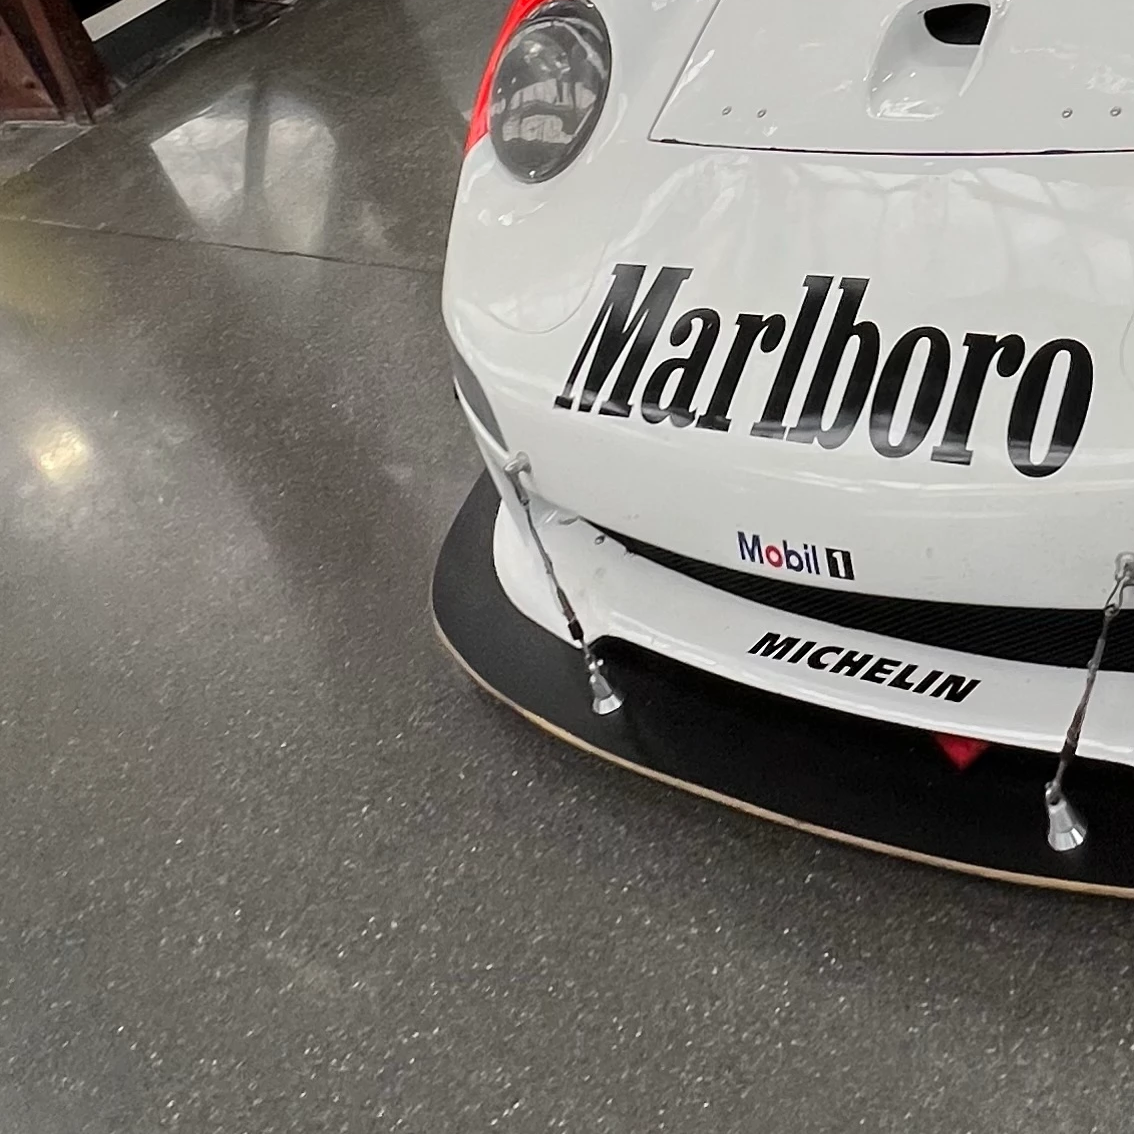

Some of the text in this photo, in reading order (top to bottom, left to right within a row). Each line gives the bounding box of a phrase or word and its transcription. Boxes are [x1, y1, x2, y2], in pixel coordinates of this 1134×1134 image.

[553, 263, 1094, 478] Marlboro
[738, 531, 854, 580] Mobil 1
[747, 632, 981, 703] MICHELIN
